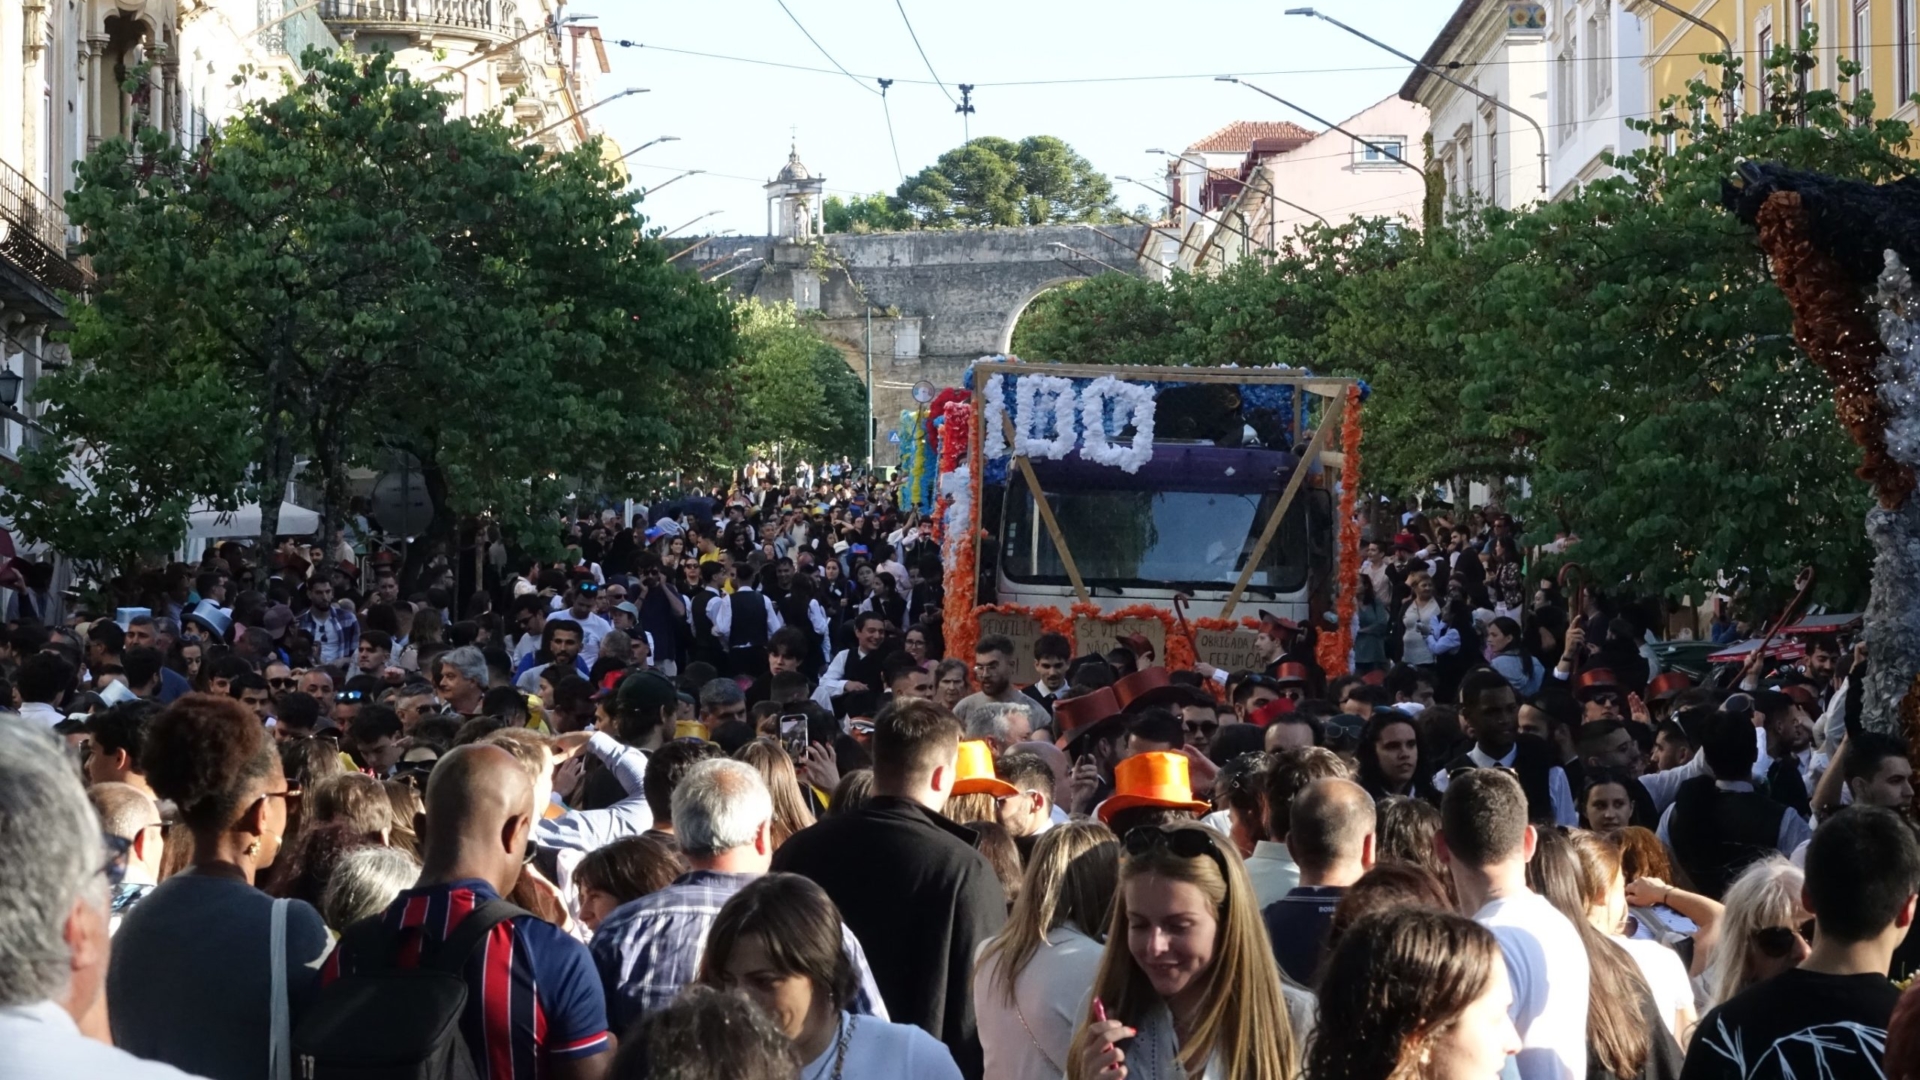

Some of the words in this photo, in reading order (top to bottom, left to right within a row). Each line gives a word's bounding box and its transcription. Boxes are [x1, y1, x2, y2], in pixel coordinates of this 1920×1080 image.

[1081, 623, 1096, 638] SE
[1201, 635, 1248, 649] OBRIGADA
[1209, 652, 1228, 666] FEZ
